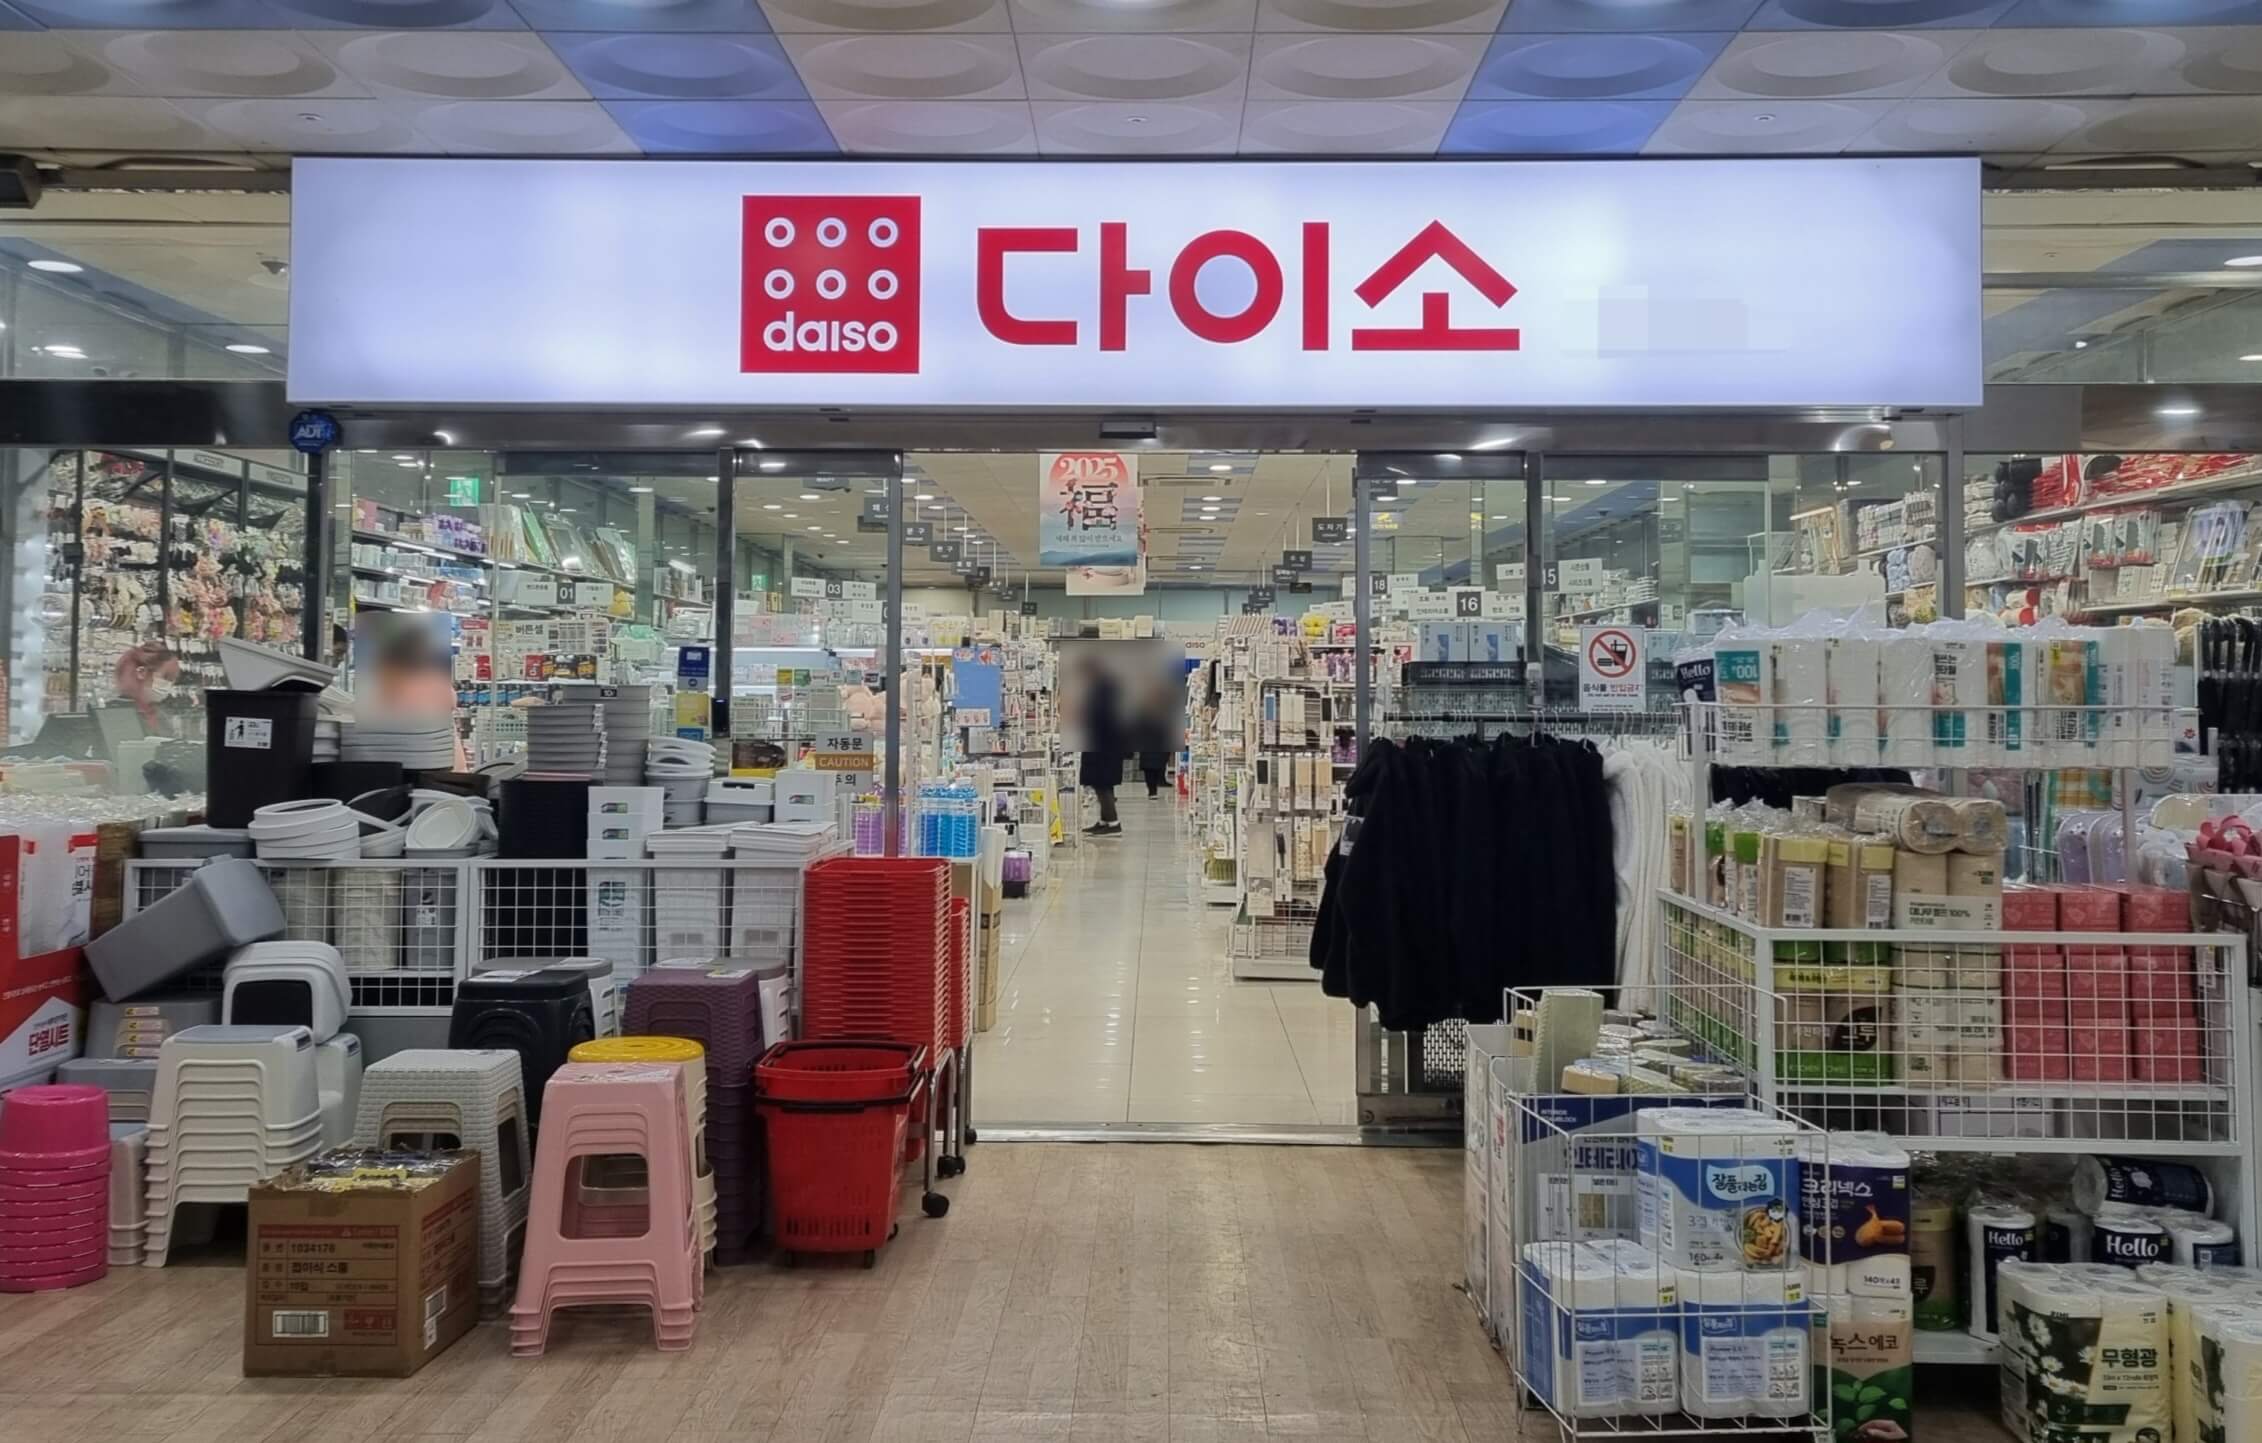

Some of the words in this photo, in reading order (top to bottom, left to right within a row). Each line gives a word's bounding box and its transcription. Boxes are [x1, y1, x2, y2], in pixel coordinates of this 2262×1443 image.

[977, 219, 1520, 351] 다이소
[763, 310, 898, 352] daiso
[1060, 457, 1119, 480] 2025
[1059, 479, 1118, 531] 福
[560, 587, 574, 600] 01
[827, 583, 841, 595] 03
[1374, 579, 1386, 591] 18
[1460, 597, 1478, 611] 16
[1680, 664, 1711, 679] Hello
[827, 738, 863, 751] 자동문
[820, 758, 869, 768] CAUTION
[28, 1024, 69, 1056] 단열시트
[1711, 1173, 1768, 1194] 잘풀리는집
[1801, 1178, 1873, 1197] 크리넥스
[1988, 1231, 2024, 1246] Hello
[2106, 1235, 2159, 1257] Hello
[2102, 1348, 2158, 1368] 무형광
